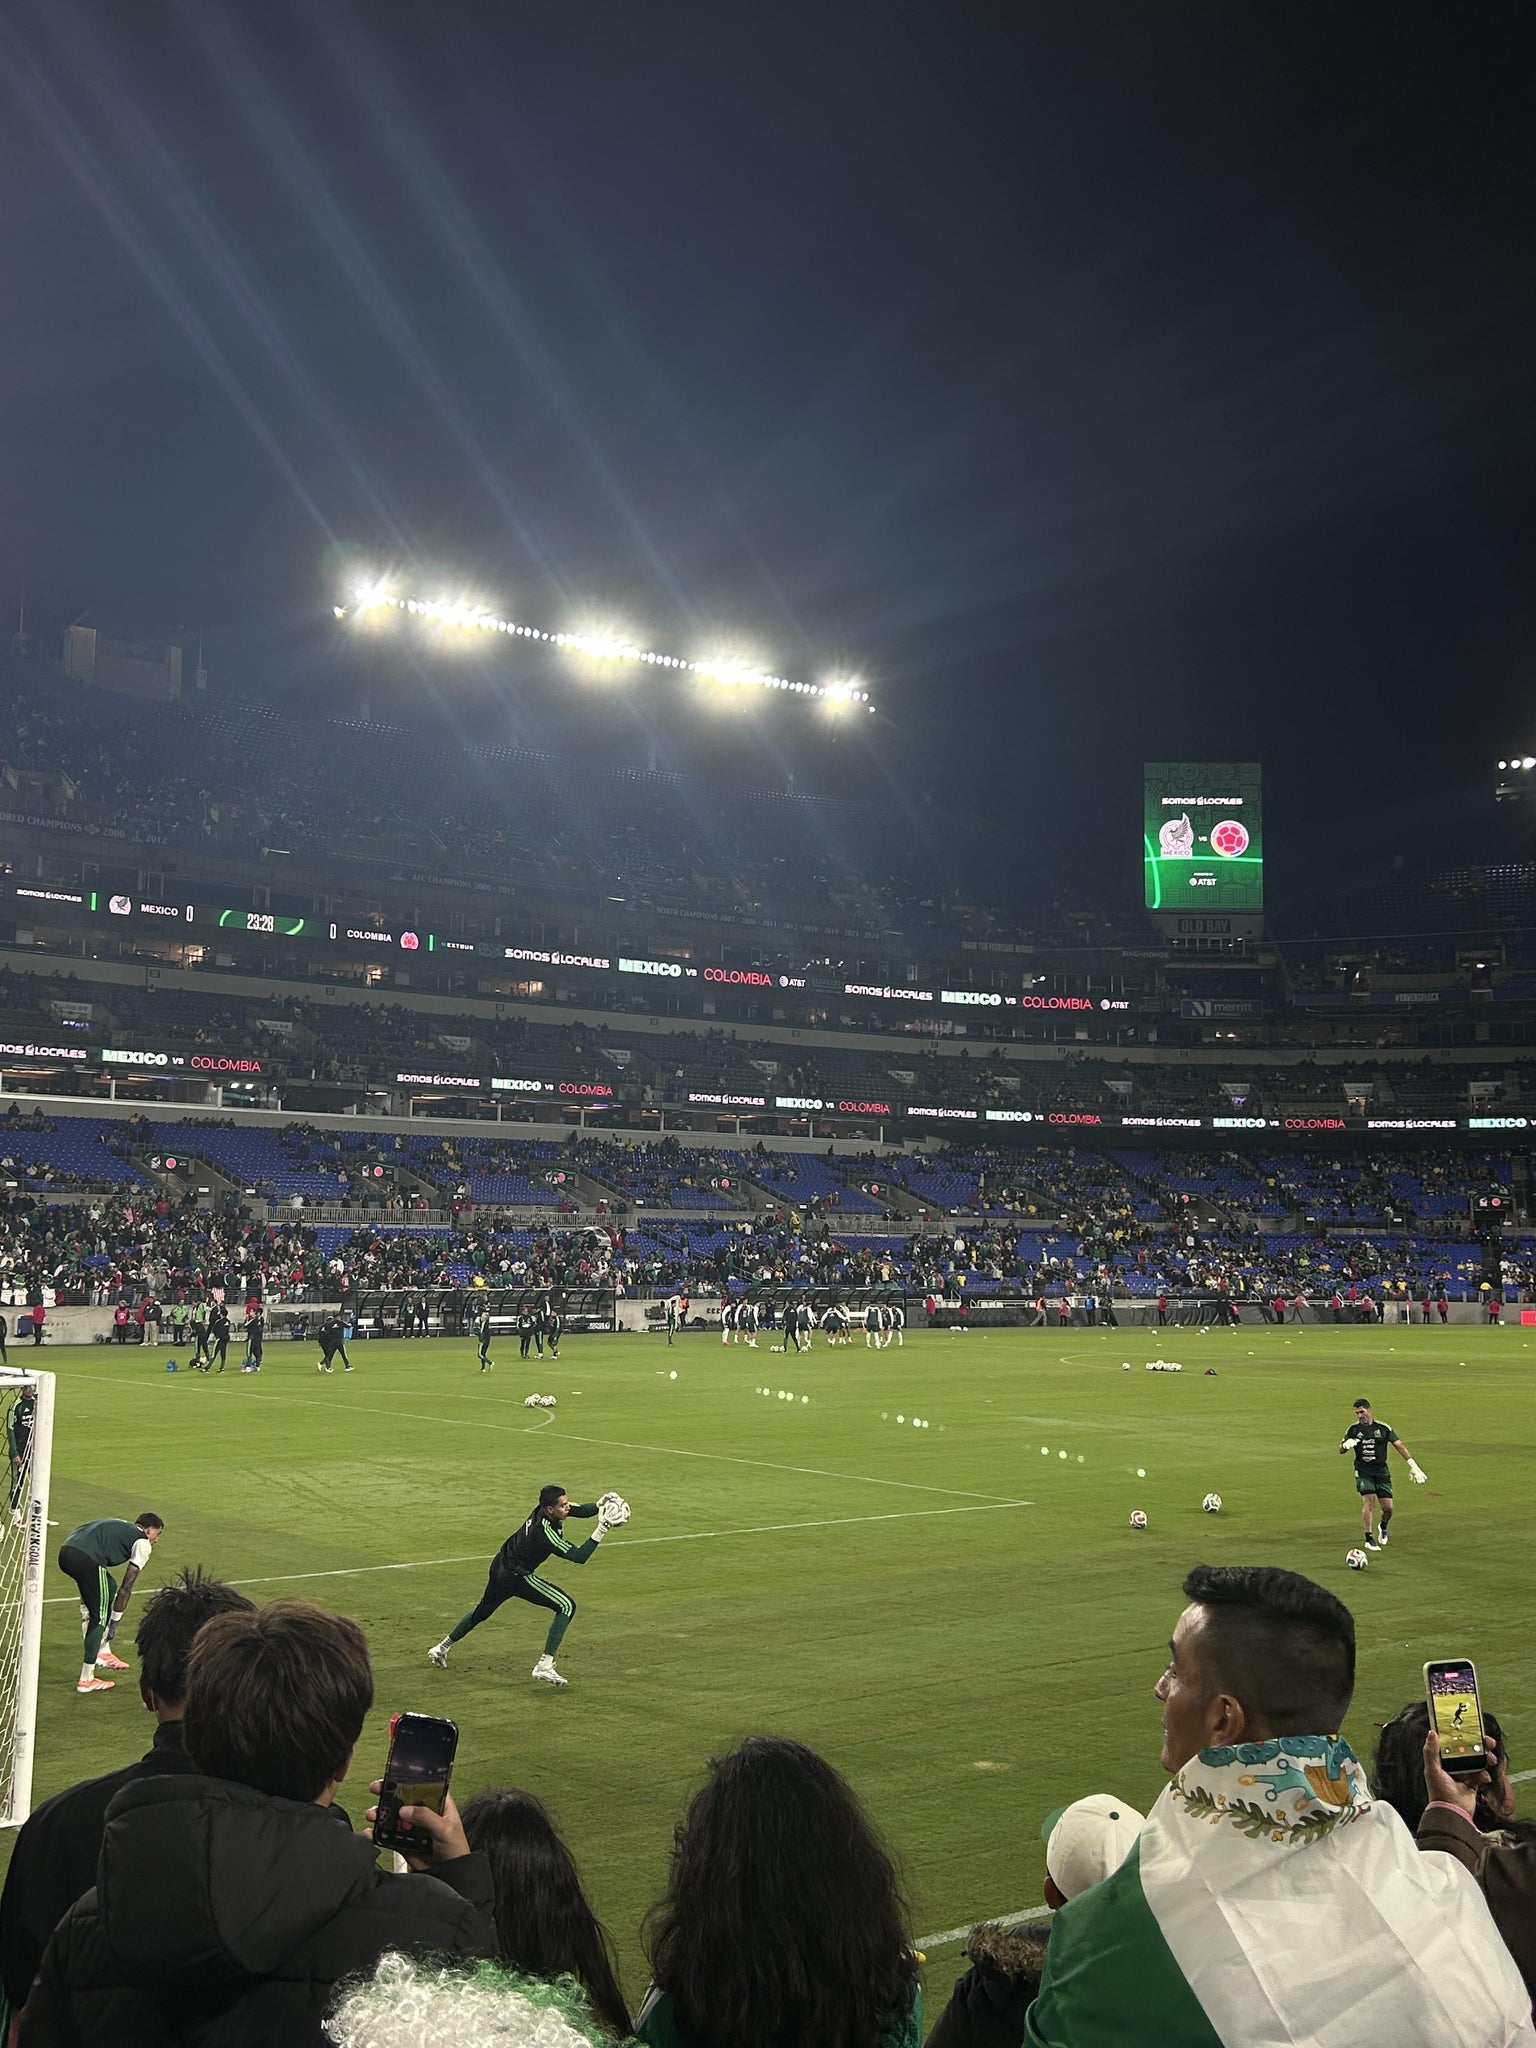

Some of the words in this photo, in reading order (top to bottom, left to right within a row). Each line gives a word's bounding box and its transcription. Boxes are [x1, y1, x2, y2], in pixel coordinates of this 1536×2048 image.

[1161, 797, 1196, 805] SOMOS
[1203, 797, 1243, 805] LOCALES
[0, 811, 24, 824] ORLD
[27, 816, 82, 833] CHAMPIONS
[102, 826, 126, 839] 2000
[145, 833, 168, 846] 2012
[428, 875, 472, 890] CHAMPIONS
[497, 886, 516, 896] 2012
[16, 889, 45, 898] SOMOS
[51, 893, 83, 903] LOCALES
[140, 904, 179, 917] MEXICO
[185, 905, 194, 923] 0
[680, 909, 718, 922] CHAMPIONS
[246, 912, 275, 933] 23:28
[1181, 919, 1204, 933] OLD
[1206, 919, 1228, 933] BAY
[329, 923, 337, 940] 0
[346, 929, 393, 943] COLOMBIA
[504, 949, 550, 963] SOMOS
[560, 955, 610, 969] LOCALES
[618, 958, 682, 978] MEXICO
[703, 967, 773, 987] COLOMBIA
[788, 978, 806, 988] AT&T
[845, 984, 883, 997] SOMOS
[891, 989, 934, 1001] LOCALES
[940, 990, 1001, 1006] MEXICO
[1022, 996, 1093, 1010] COLOMBIA
[1110, 1001, 1130, 1009] AT&T
[1214, 1002, 1253, 1012] merritt
[35, 1048, 87, 1059] LOCALES
[101, 1049, 168, 1066] MEXICO
[190, 1056, 261, 1073] COLOMBIA
[396, 1073, 432, 1084] SOMOS
[440, 1076, 480, 1087] LOCALES
[491, 1078, 542, 1092] MEXICO
[558, 1082, 614, 1096] COLOMBIA
[688, 1093, 721, 1103] SOMOS
[728, 1096, 766, 1106] LOCALES
[775, 1096, 823, 1110] MEXICO
[838, 1100, 890, 1114] COLOMBIA
[907, 1107, 938, 1117] SOMOS
[944, 1109, 978, 1119] LOCALES
[985, 1110, 1032, 1122] MEXICO
[1049, 1112, 1102, 1125] COLOMBIA
[1121, 1117, 1156, 1126] SOMOS
[1162, 1118, 1202, 1127] LOCALES
[1212, 1117, 1267, 1129] MEXICO
[1285, 1118, 1346, 1129] COLOMBIA
[1367, 1120, 1405, 1129] SOMOS
[1412, 1120, 1457, 1128] LOCALES
[1468, 1117, 1528, 1129] MEXICO
